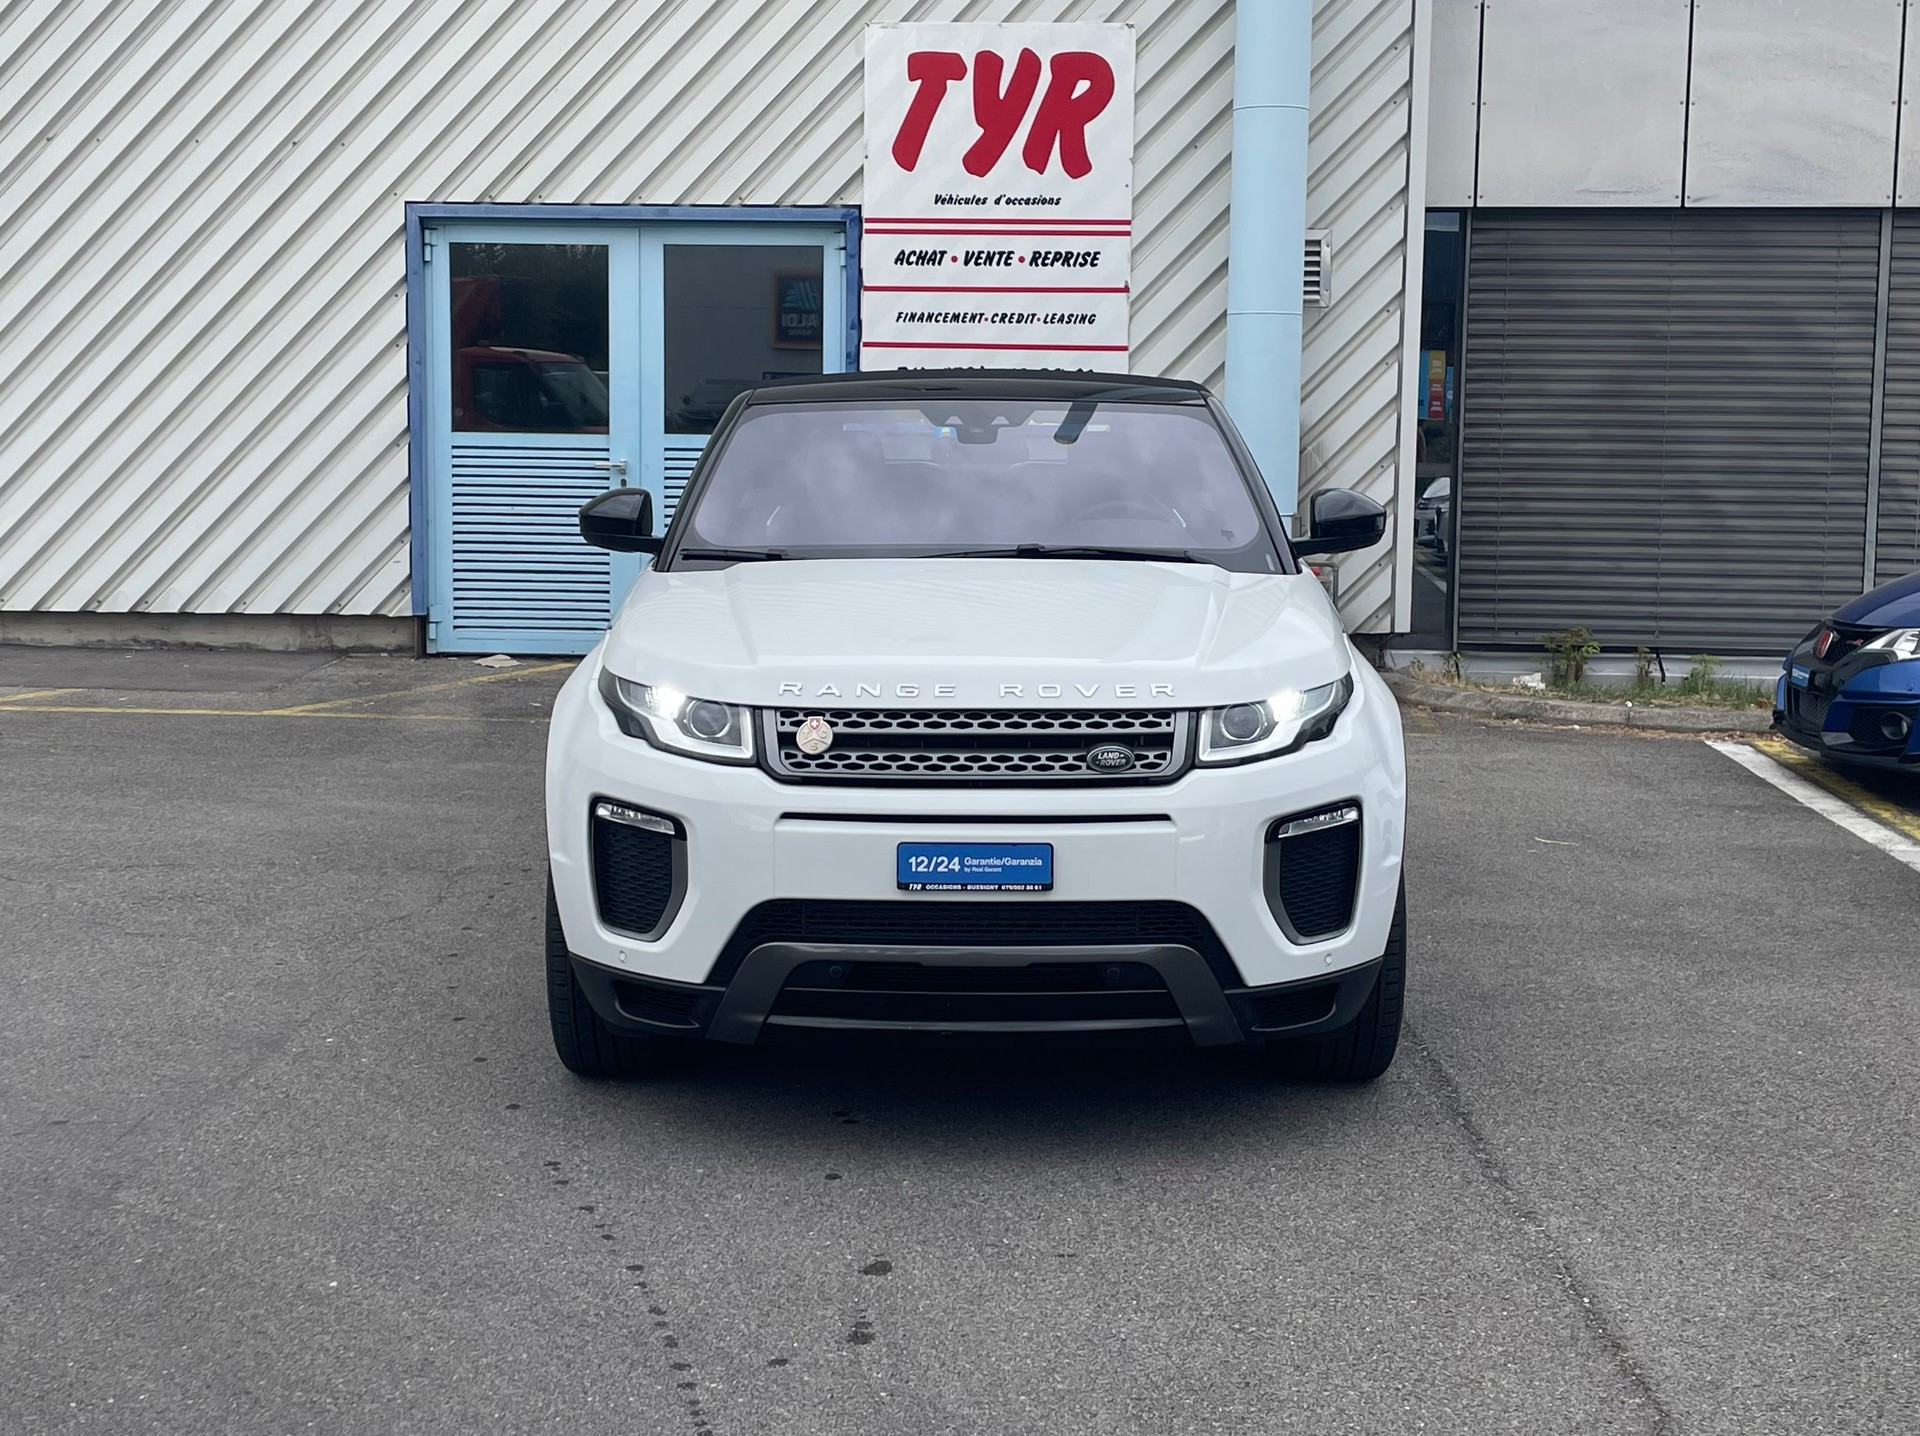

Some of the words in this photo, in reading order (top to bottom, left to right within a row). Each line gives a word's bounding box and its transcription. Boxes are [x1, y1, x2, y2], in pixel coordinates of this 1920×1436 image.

[892, 47, 1115, 180] TYR
[933, 193, 987, 206] Véhicules
[994, 193, 1061, 206] d'occasions
[894, 249, 947, 267] ACHAT
[963, 250, 1015, 267] VENTE
[1029, 250, 1101, 268] REPRISE
[896, 311, 985, 325] FINANCEMENT
[990, 312, 1037, 325] CREDIT
[1043, 312, 1097, 326] LEASING
[778, 682, 957, 699] RANGE
[999, 682, 1176, 699] ROVER
[1097, 752, 1120, 760] LAND
[1099, 758, 1126, 766] ROVER
[908, 856, 961, 872] 12/24
[964, 856, 1043, 866] Garantie/Garanzia
